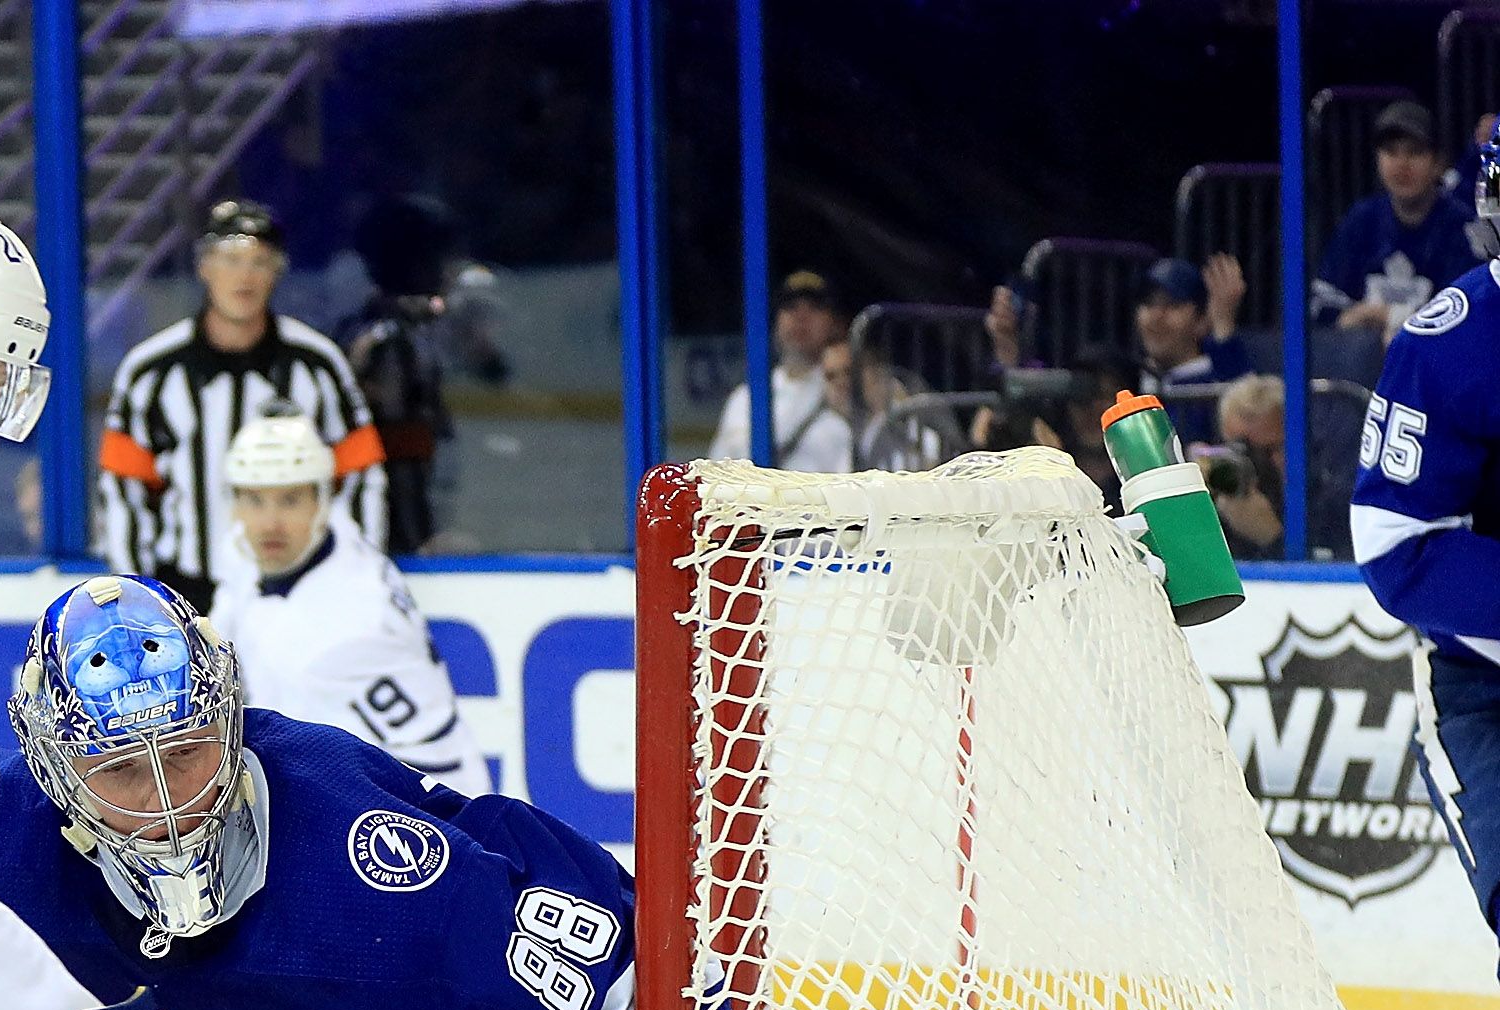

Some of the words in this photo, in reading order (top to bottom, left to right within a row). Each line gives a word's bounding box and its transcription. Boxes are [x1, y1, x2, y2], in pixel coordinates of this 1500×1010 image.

[1360, 391, 1427, 486] 55
[349, 675, 418, 743] 19
[362, 814, 434, 838] LIGHTNING
[356, 832, 369, 861] BAY
[365, 861, 411, 884] TAMPA
[146, 935, 167, 949] NHL
